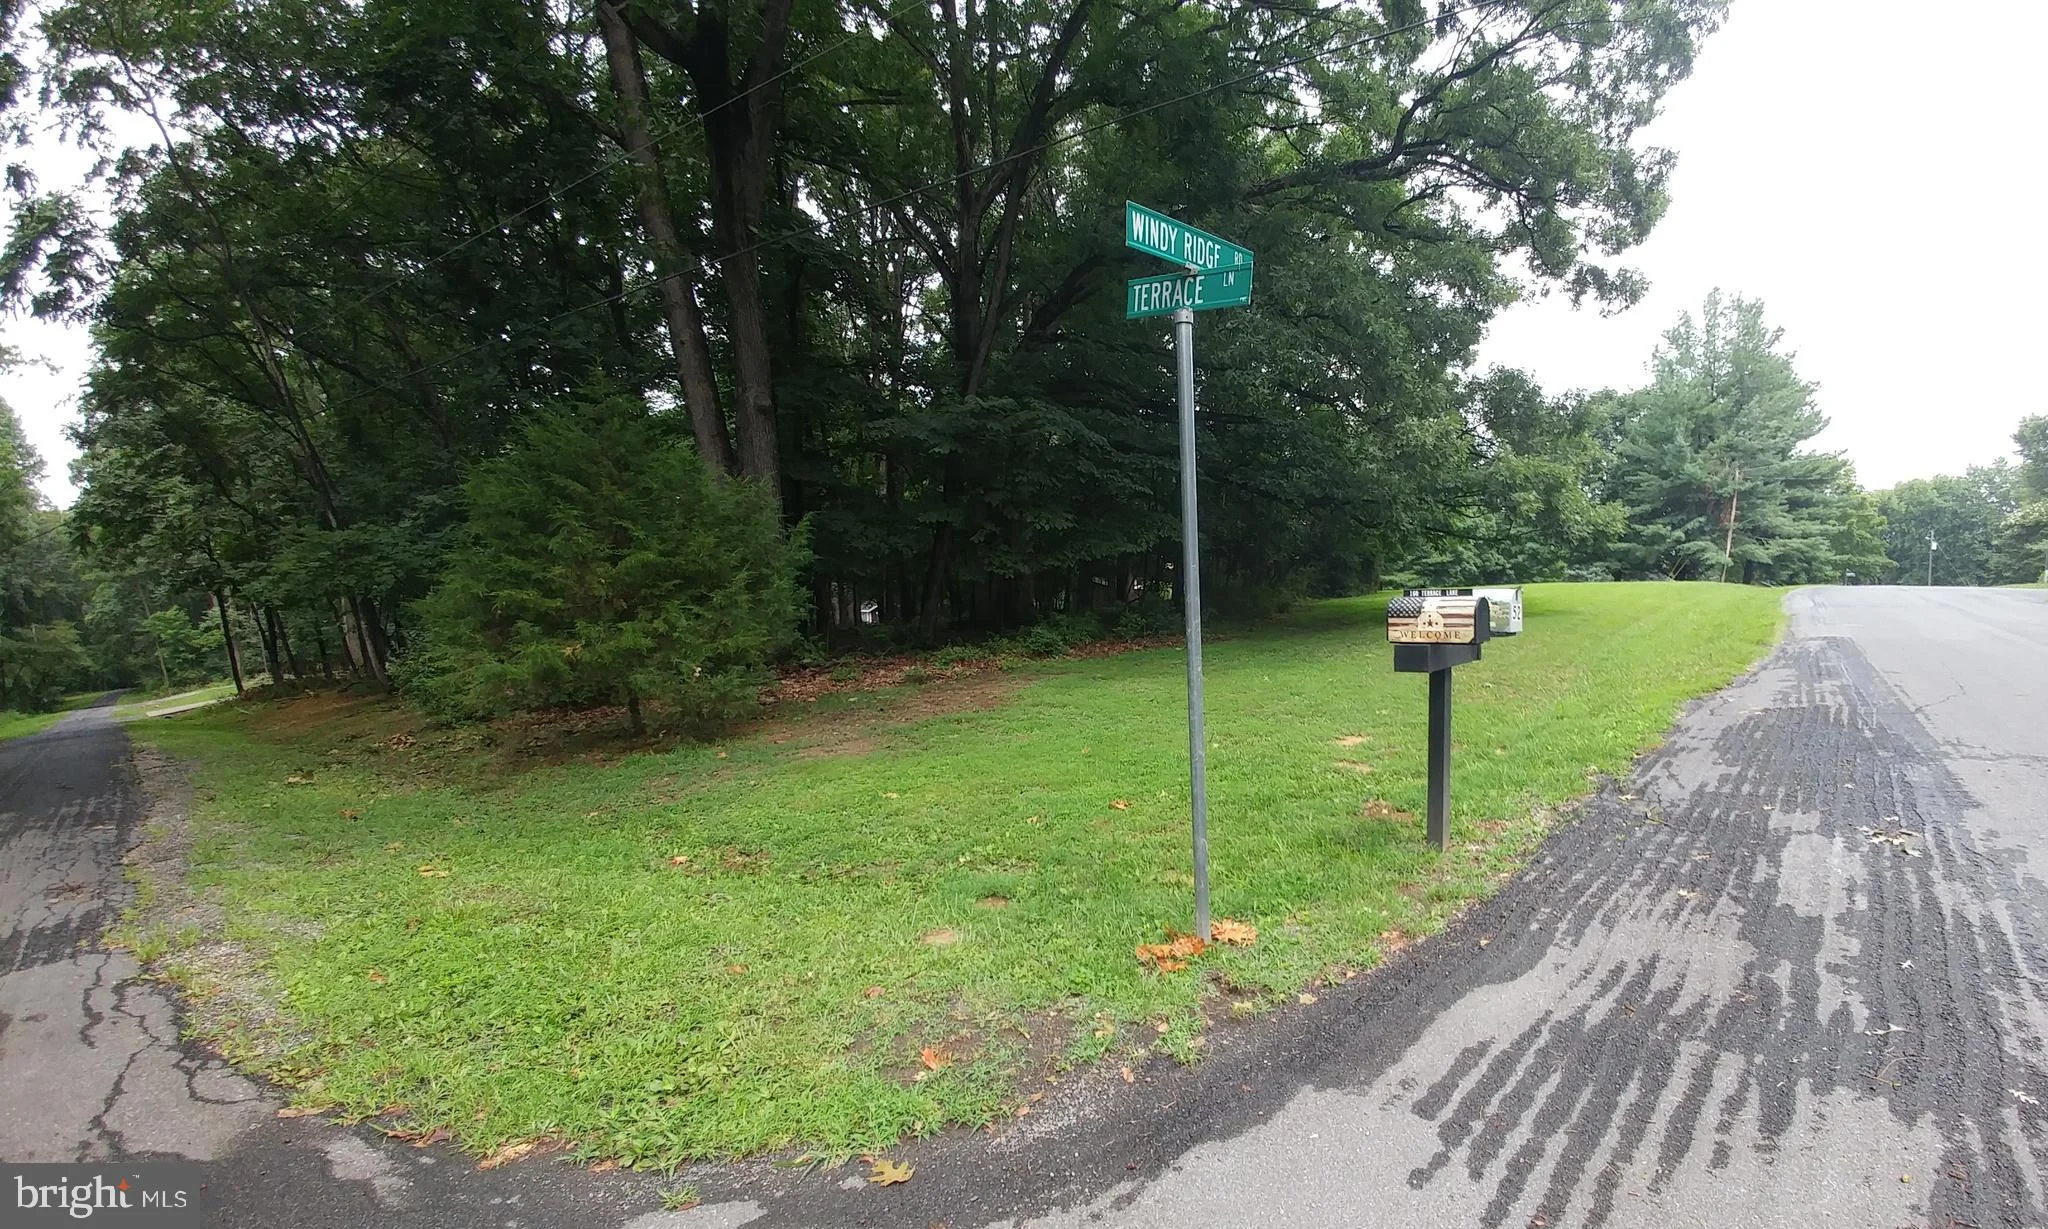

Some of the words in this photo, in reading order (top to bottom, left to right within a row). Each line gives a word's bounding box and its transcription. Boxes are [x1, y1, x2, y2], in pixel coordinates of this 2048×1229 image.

[1132, 210, 1178, 255] WINDY
[1184, 231, 1221, 269] RIDGE
[1133, 275, 1205, 312] TERRACE
[1223, 271, 1235, 287] LN
[1511, 605, 1521, 620] 52
[1399, 630, 1462, 640] WELCOME
